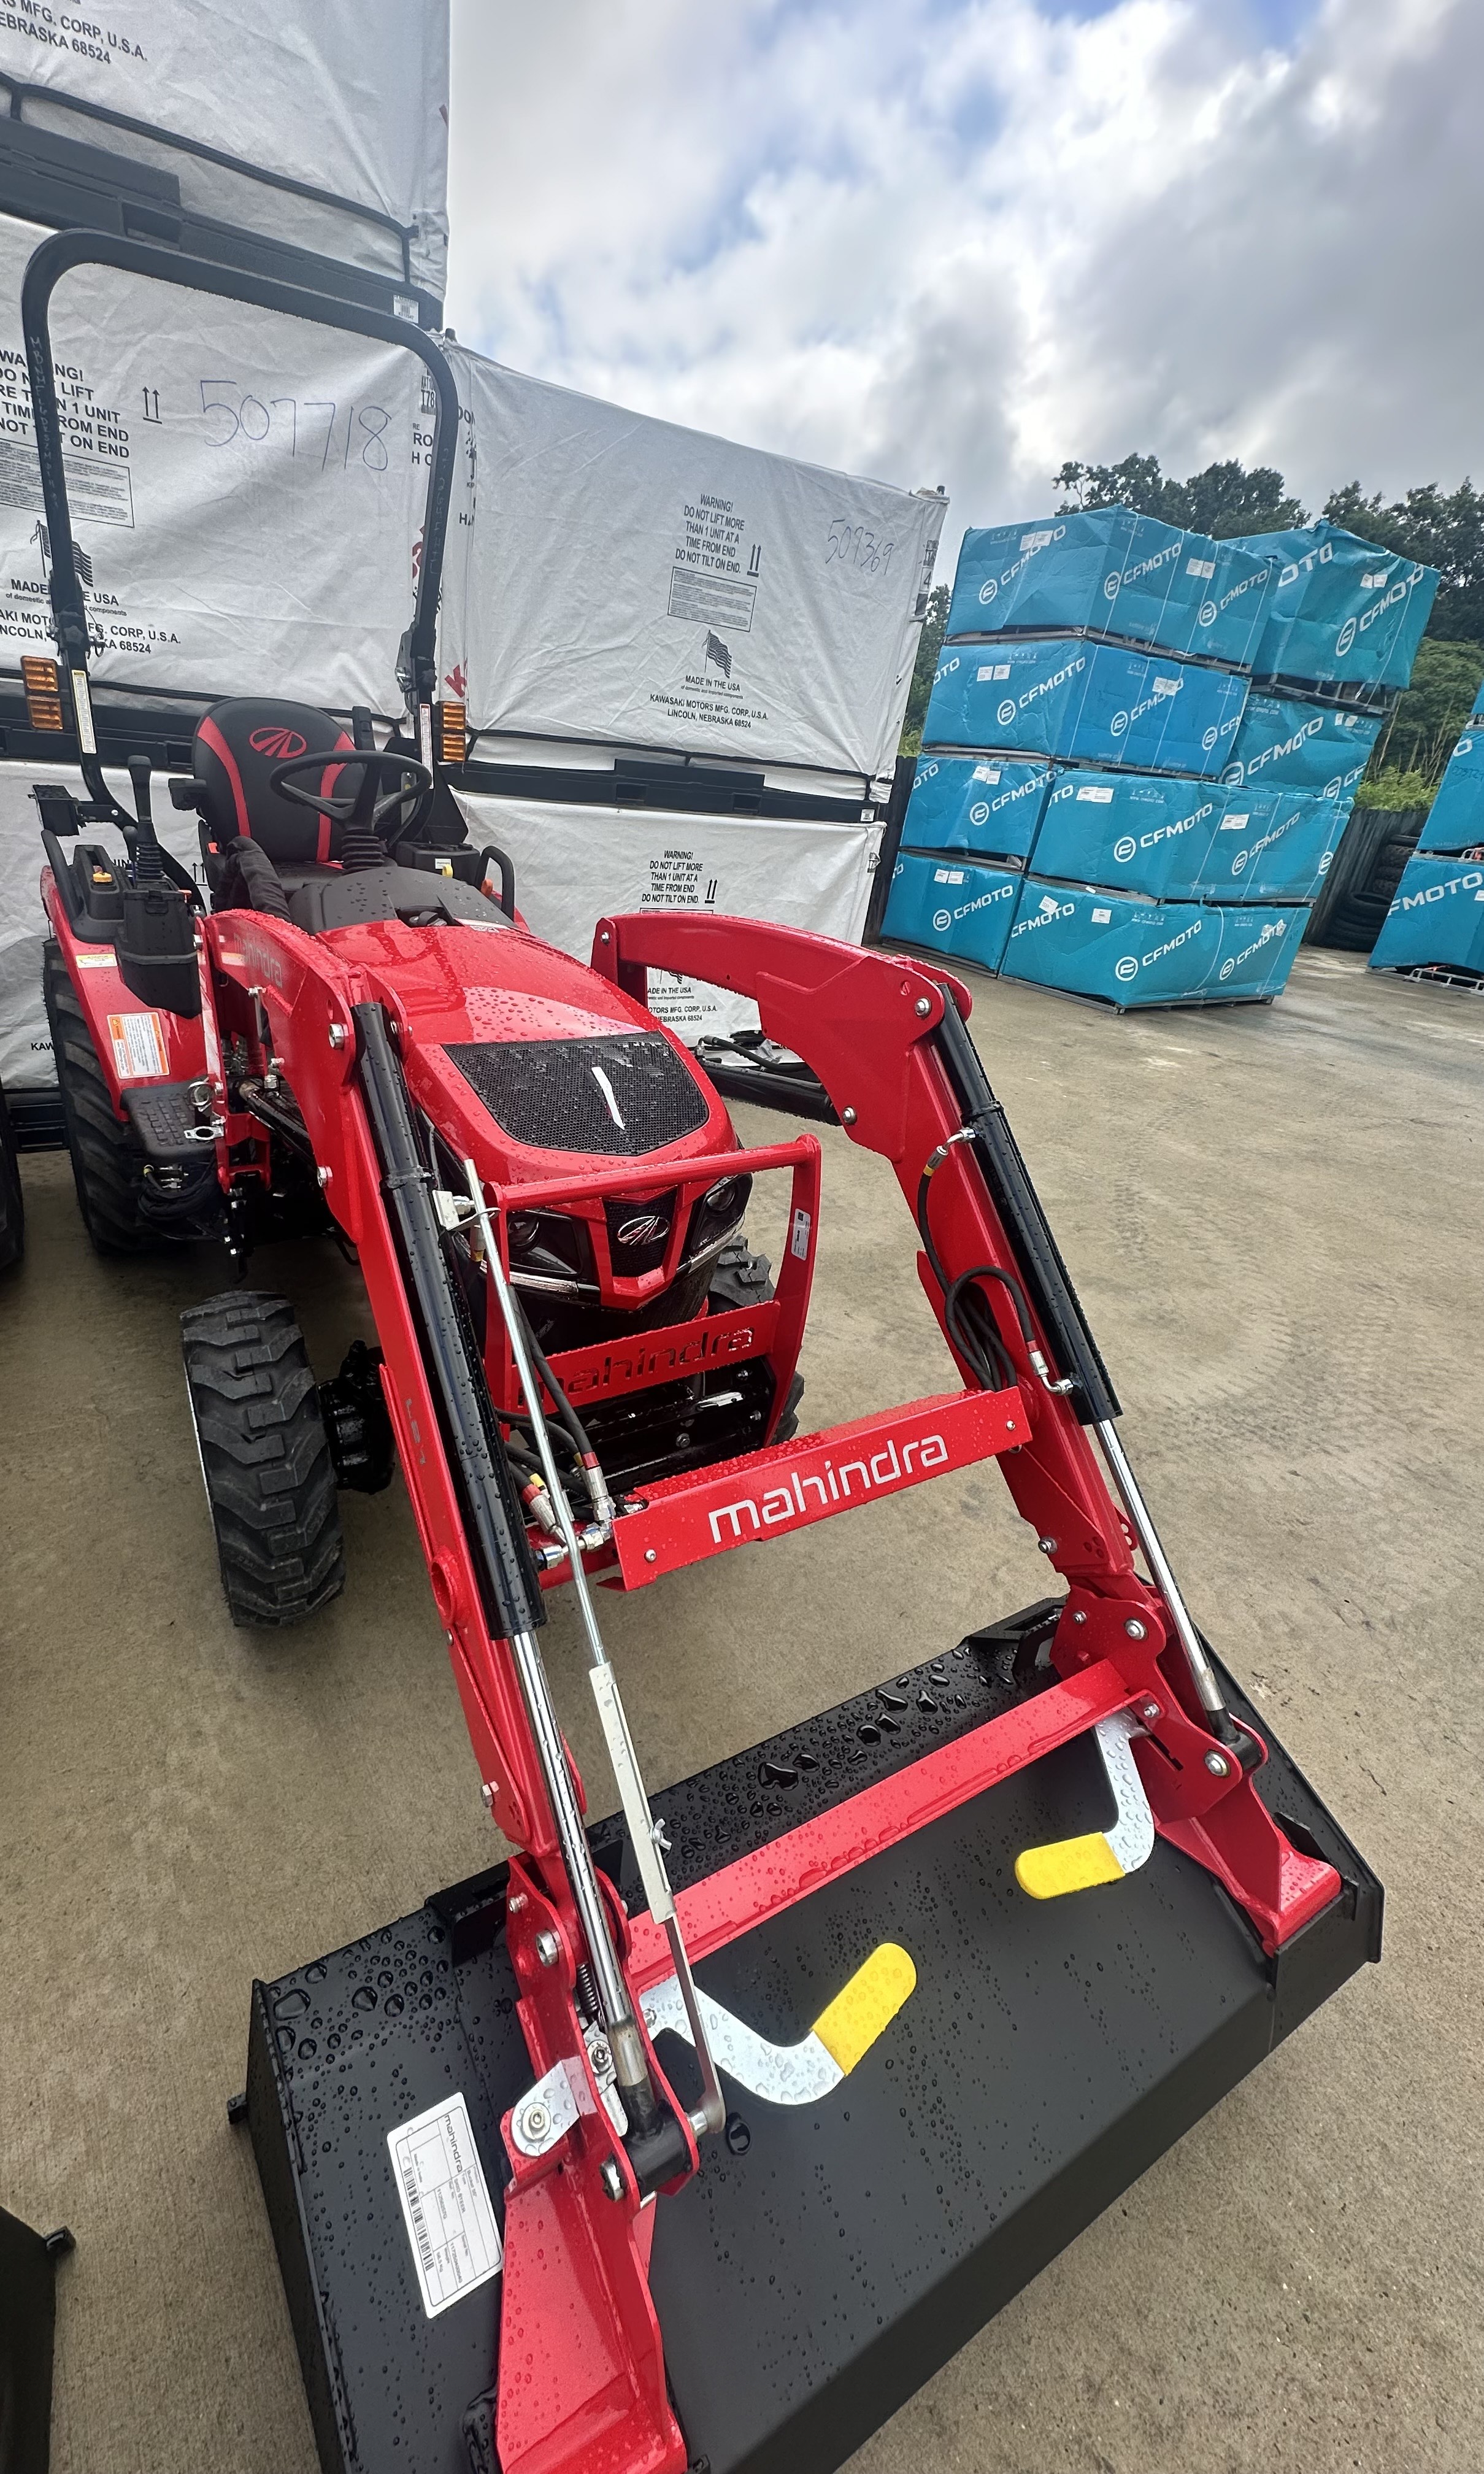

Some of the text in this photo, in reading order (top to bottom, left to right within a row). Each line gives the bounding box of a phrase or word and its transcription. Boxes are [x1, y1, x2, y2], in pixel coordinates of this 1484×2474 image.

[0, 12, 110, 64] EBRASKA 68524
[21, 0, 56, 26] MFG.
[108, 31, 148, 61] U.S.A.
[61, 382, 94, 401] LIFT
[2, 402, 35, 420] TIM
[58, 415, 93, 434] ROM
[98, 425, 129, 442] END
[72, 403, 79, 414] 1
[85, 407, 120, 424] UNIT
[200, 380, 392, 472] 507718
[71, 435, 93, 451] ON
[98, 441, 129, 458] END
[700, 493, 734, 513] WARNING!
[684, 505, 745, 531] DO NOT LIFT MORE
[686, 520, 740, 544] THAN 1 UNIT AT A
[686, 536, 736, 558] TIME FROM END
[675, 548, 741, 574] DO NOT TILT ON END.
[1123, 542, 1182, 585] CFMOTO
[94, 593, 119, 606] USA
[88, 622, 107, 635] FG.
[148, 630, 181, 644] U.S.A.
[120, 641, 152, 654] 68524
[685, 675, 704, 686] MADE
[713, 680, 726, 690] THE
[728, 682, 740, 692] USA
[1018, 657, 1086, 709] CFMOTO
[650, 693, 685, 706] KAWASAKI
[686, 699, 713, 712] MOTORS
[715, 704, 730, 714] MFG.
[751, 710, 769, 720] U.S.A.
[667, 708, 752, 729] LINCOLN, NEBRASKA 68524
[1247, 716, 1324, 776] CFMOTO
[991, 770, 1056, 812] CFMOTO
[1140, 802, 1213, 848] CFMOTO
[1249, 812, 1301, 858] CFMOTO
[649, 860, 703, 871] DO NOT LIFT MORE
[664, 850, 694, 860] WARNING!
[651, 872, 667, 881] THAN
[668, 873, 672, 881] 1
[672, 873, 686, 882] UNIT
[693, 874, 698, 882] A
[651, 883, 694, 893] TIME FROM END
[642, 893, 699, 904] DO NOT TILT ON END.
[953, 885, 1013, 920] CFMOTO
[1387, 871, 1483, 917] FMOTO
[1142, 920, 1202, 966] CFMOTO
[707, 1433, 950, 1544] mahindra
[444, 2113, 464, 2173] mahindra
